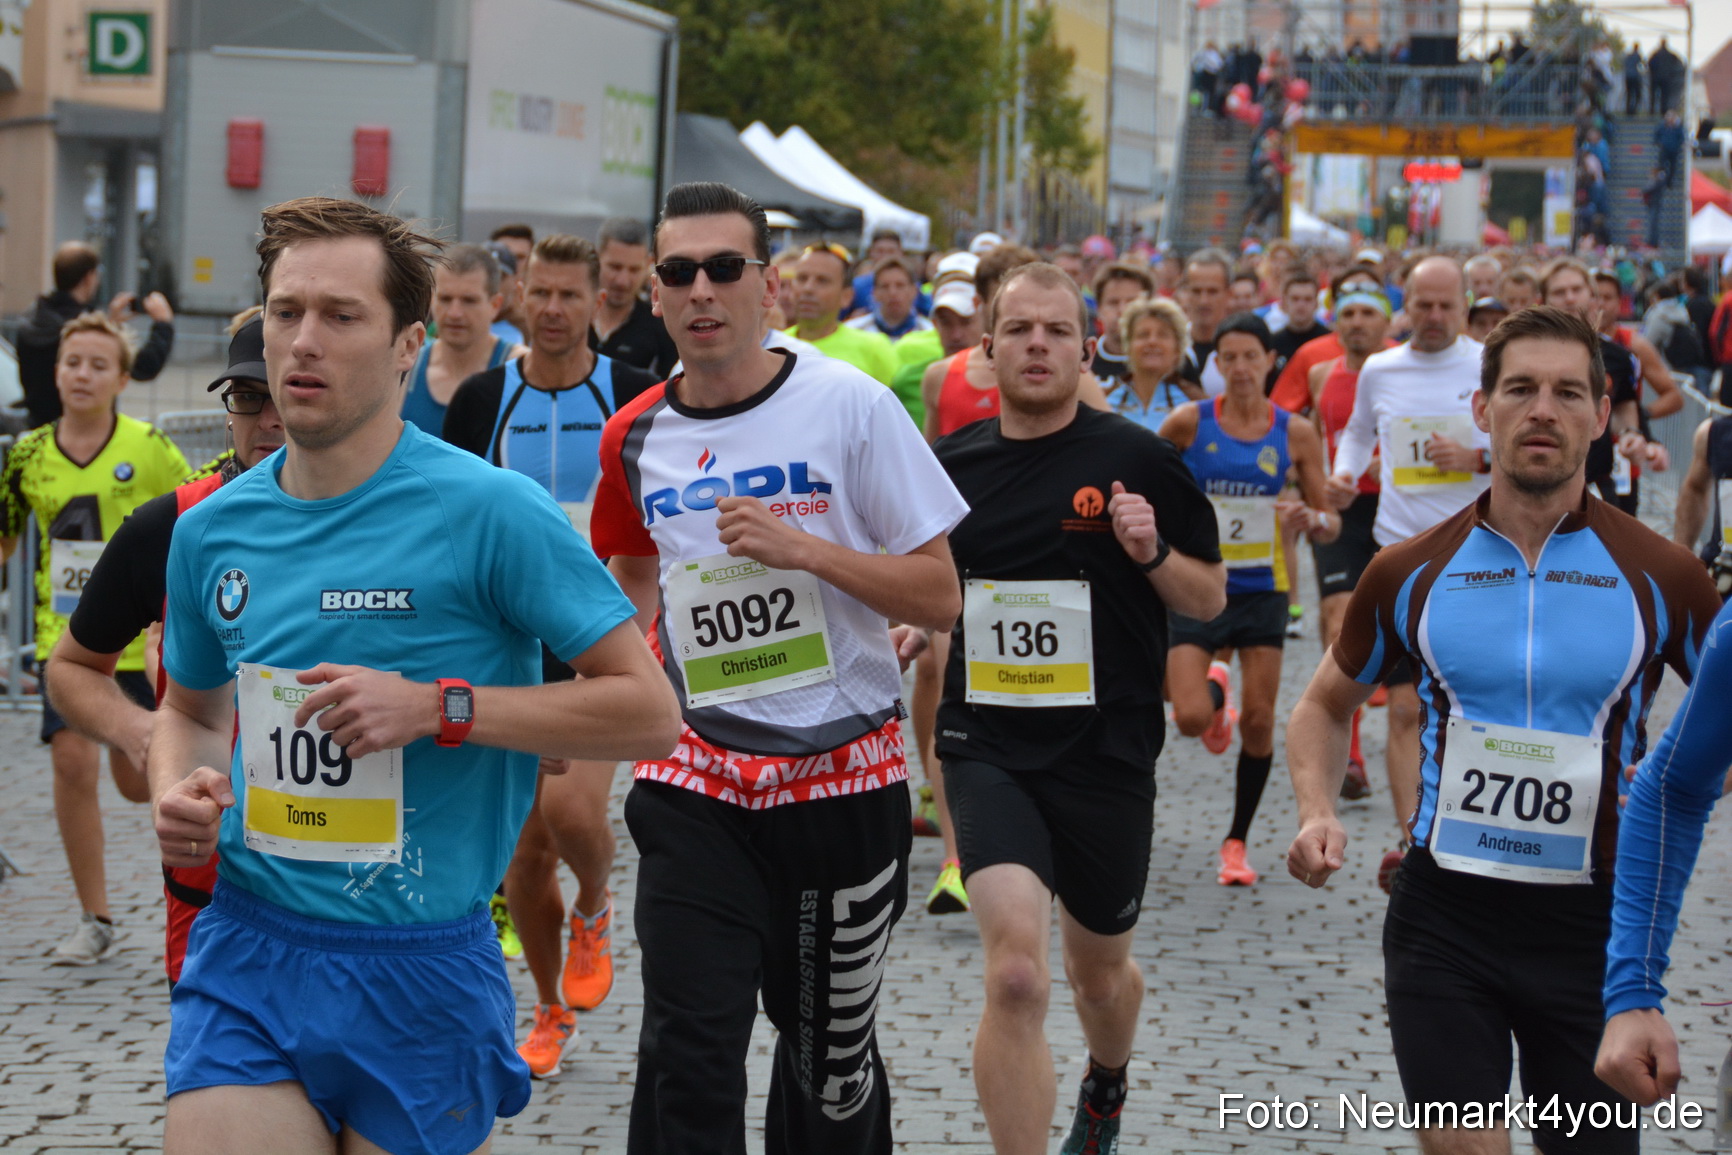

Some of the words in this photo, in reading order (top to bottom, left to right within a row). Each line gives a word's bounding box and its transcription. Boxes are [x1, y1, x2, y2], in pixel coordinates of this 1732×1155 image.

[95, 18, 144, 69] D
[769, 489, 829, 518] ergie
[1230, 519, 1244, 540] 2
[219, 570, 248, 588] BMW
[713, 561, 767, 581] BOCK
[1583, 574, 1618, 588] RACER
[320, 589, 415, 611] BOCK
[1004, 593, 1049, 605] BOCK
[382, 612, 417, 621] concepts
[690, 587, 800, 648] 5092
[990, 619, 1059, 658] 136
[684, 646, 690, 654] S
[721, 651, 788, 677] Christian
[997, 670, 1055, 685] Christian
[283, 687, 317, 704] BO
[942, 729, 968, 740] SPIRO
[269, 726, 353, 787] 109
[1500, 740, 1555, 759] BOCK
[249, 767, 255, 779] A
[1445, 802, 1452, 811] D
[1460, 768, 1573, 825] 2708
[286, 804, 327, 827] Toms
[1477, 832, 1542, 856] Andreas
[350, 888, 363, 899] 17.
[799, 890, 819, 1019] ESTABLISHED
